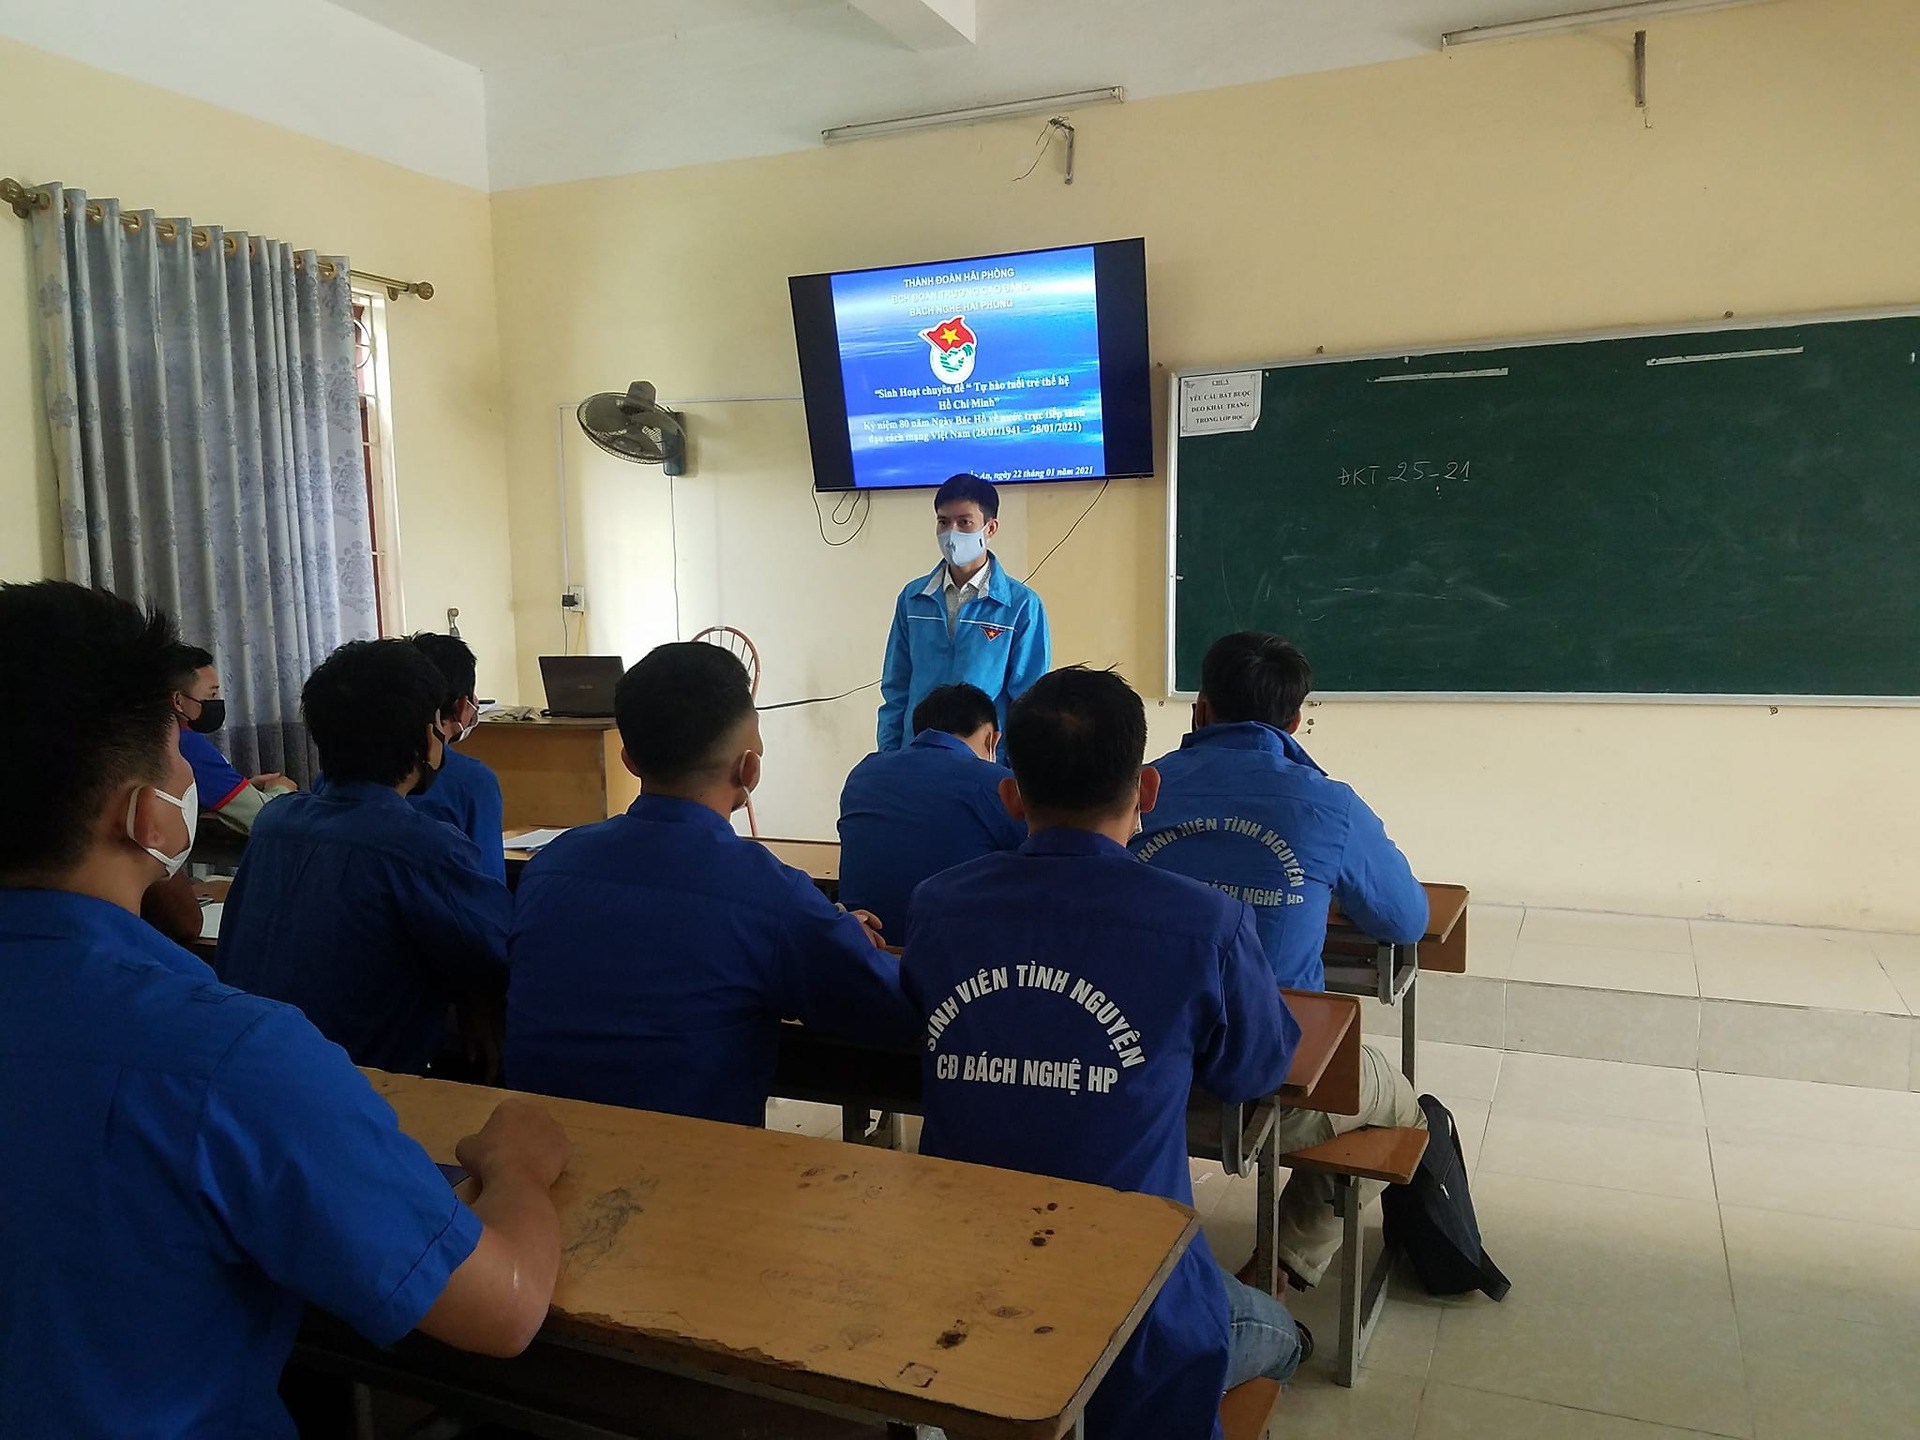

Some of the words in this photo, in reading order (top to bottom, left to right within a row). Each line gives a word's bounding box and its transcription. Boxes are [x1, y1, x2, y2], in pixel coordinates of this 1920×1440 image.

[903, 275, 934, 288] THÀNH
[936, 273, 962, 285] ĐOÀN
[964, 270, 980, 281] HẢI
[982, 267, 1015, 279] PHÒNG
[900, 387, 920, 399] Hoạt
[938, 397, 952, 410] Hồ
[953, 398, 970, 410] Chí
[1013, 469, 1022, 478] 22
[1046, 467, 1055, 477] 01
[1075, 465, 1094, 476] 2021
[1337, 465, 1381, 486] ĐKT
[1132, 829, 1178, 864] HANH
[1223, 816, 1262, 838] TÌNH
[1260, 829, 1305, 888] NGUYỆN
[955, 966, 1009, 1004] VIÊN
[1016, 960, 1070, 993] TÌNH
[1068, 978, 1147, 1068] NGUYỆN
[936, 1053, 959, 1080] CĐ
[963, 1051, 1017, 1085] BÁCH
[1022, 1058, 1082, 1096] NGHỆ
[1087, 1065, 1119, 1094] HP
